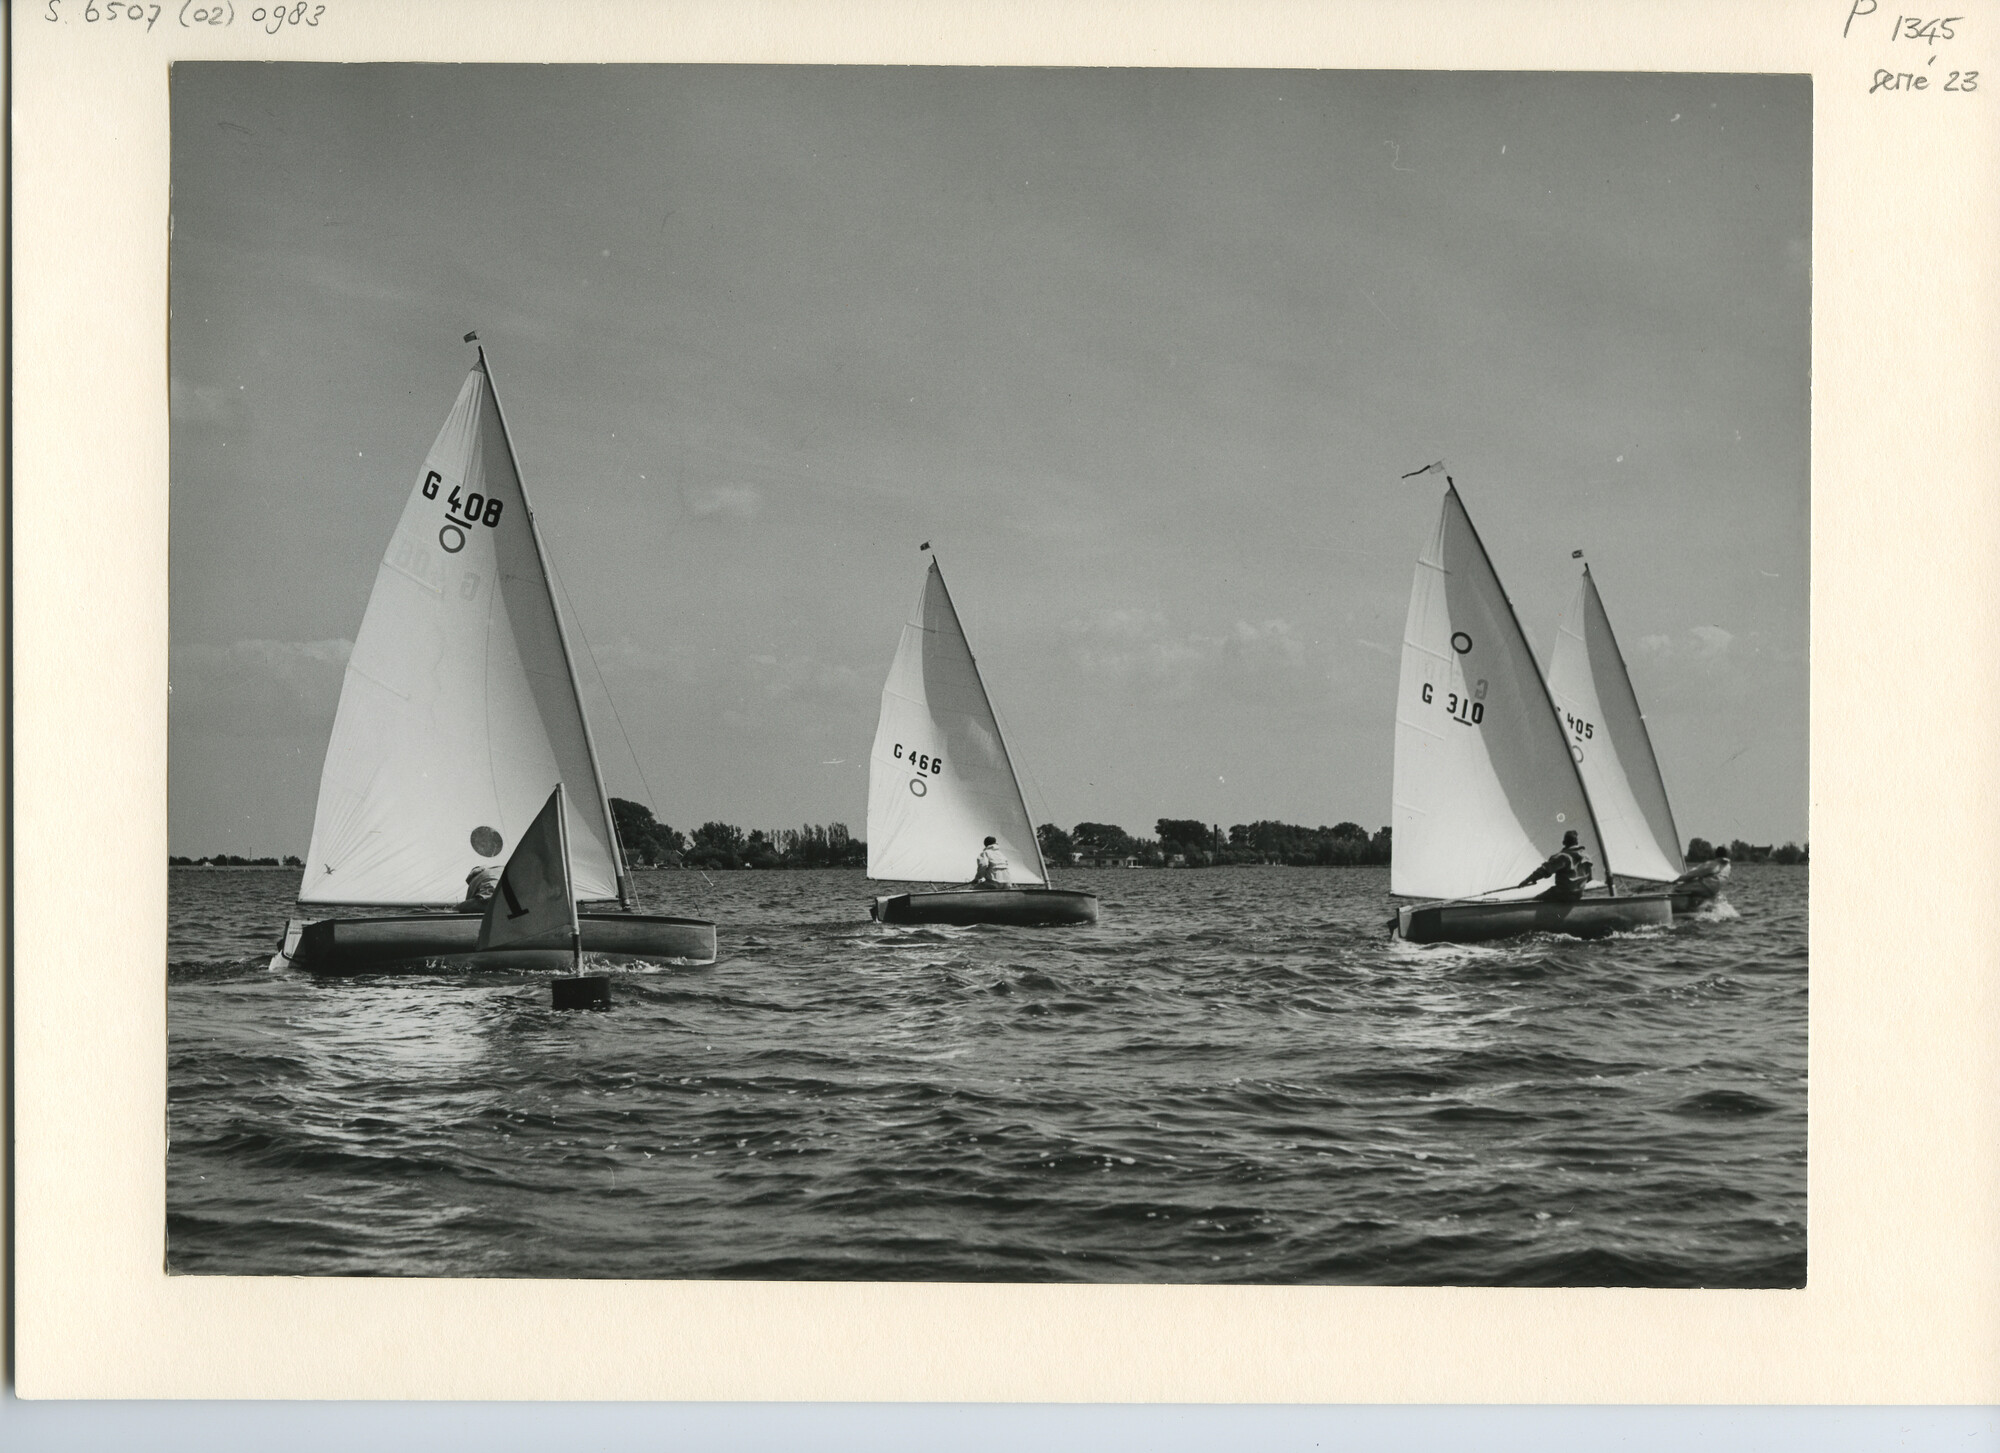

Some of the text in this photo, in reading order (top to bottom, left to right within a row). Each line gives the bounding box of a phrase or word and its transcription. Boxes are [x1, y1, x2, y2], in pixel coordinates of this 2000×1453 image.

[84, 0, 162, 33] 6507
[178, 0, 235, 28] (02)
[251, 1, 327, 35] 0983
[1891, 15, 1965, 46] 1345
[1943, 70, 1980, 93] 23
[421, 470, 504, 529] G 408
[1421, 682, 1485, 725] G 310
[1566, 712, 1595, 740] 405
[893, 743, 942, 775] G 466
